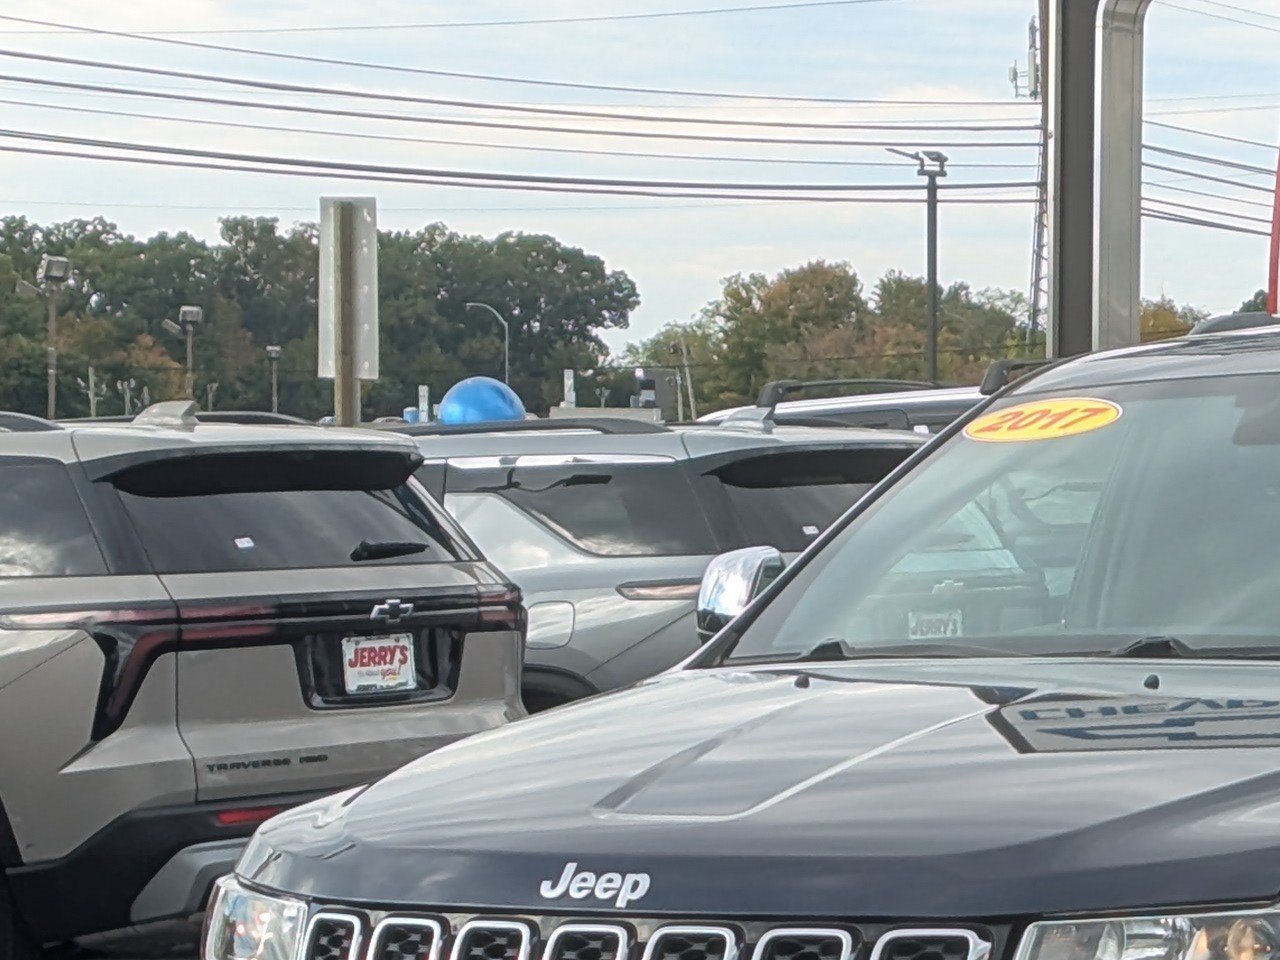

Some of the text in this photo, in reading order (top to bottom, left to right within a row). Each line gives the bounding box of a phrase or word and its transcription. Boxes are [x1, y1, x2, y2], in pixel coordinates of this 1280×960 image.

[974, 407, 1111, 433] 2017
[348, 645, 409, 668] JERRY'S
[206, 758, 292, 773] TRAVERSE
[540, 862, 651, 908] Jeep
